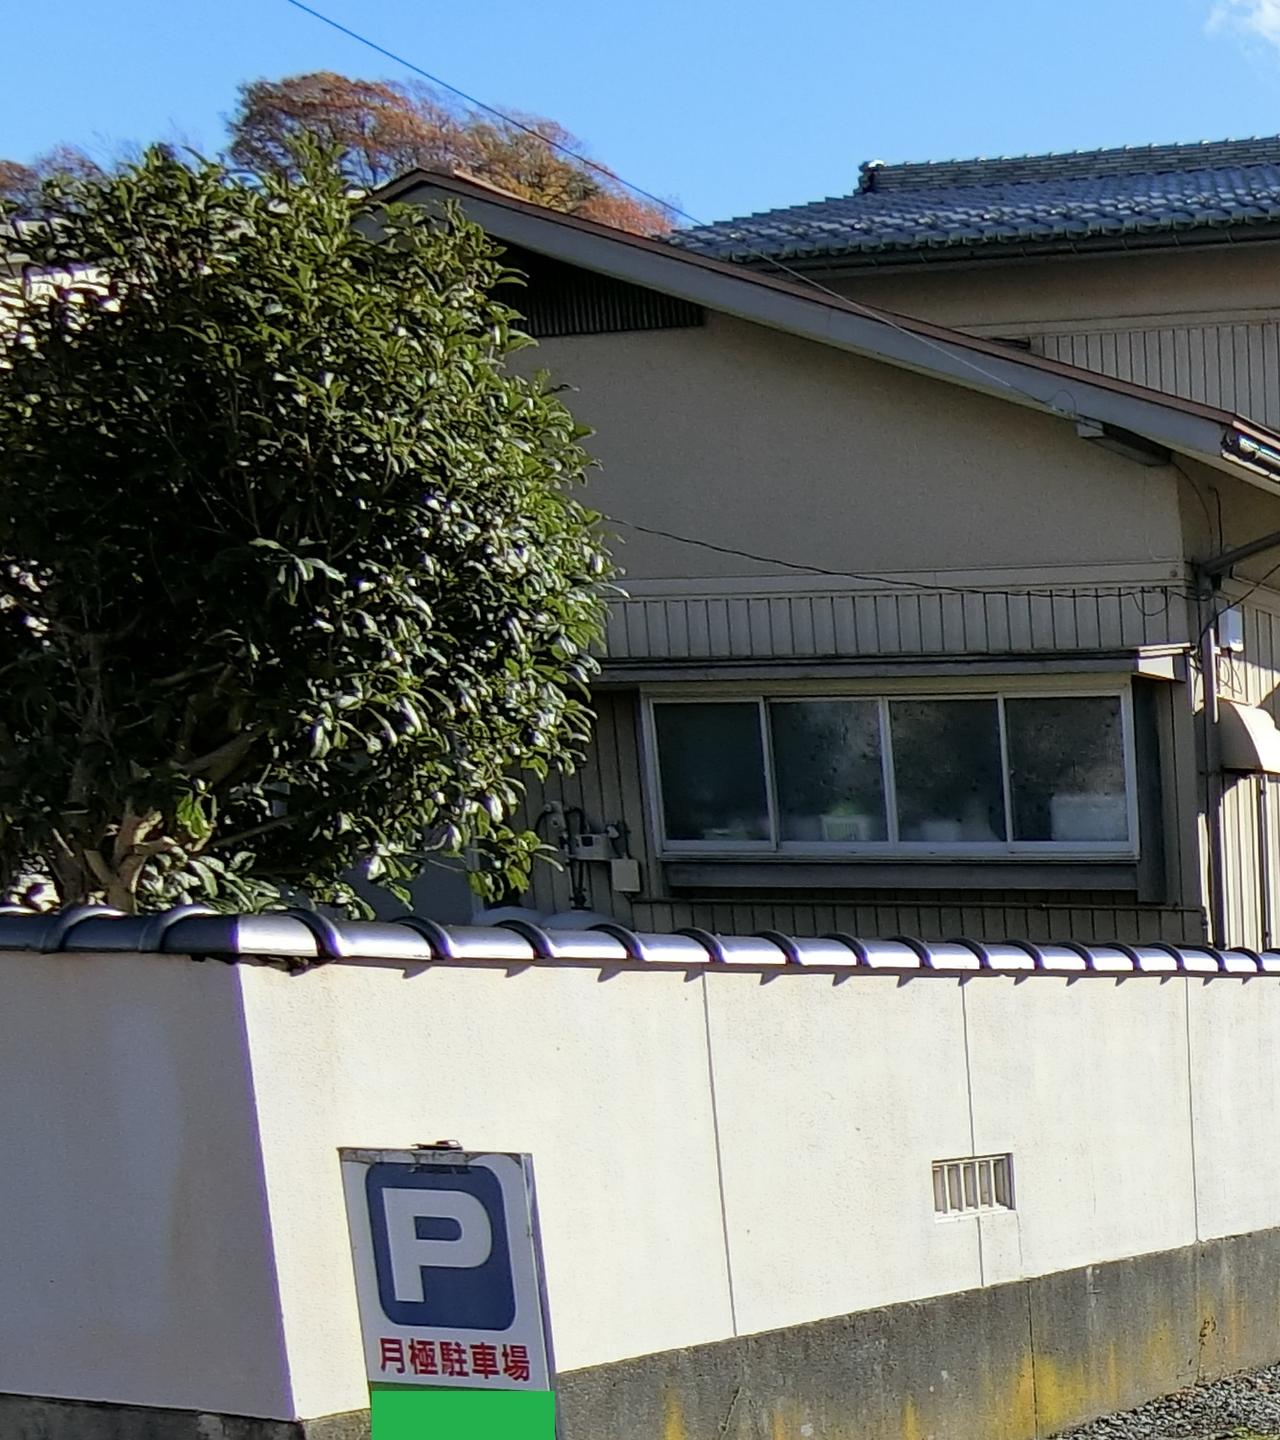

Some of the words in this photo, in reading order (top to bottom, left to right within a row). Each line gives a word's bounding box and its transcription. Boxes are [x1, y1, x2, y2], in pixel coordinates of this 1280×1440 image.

[382, 1188, 492, 1302] P
[380, 1337, 530, 1381] 月極駐車場
